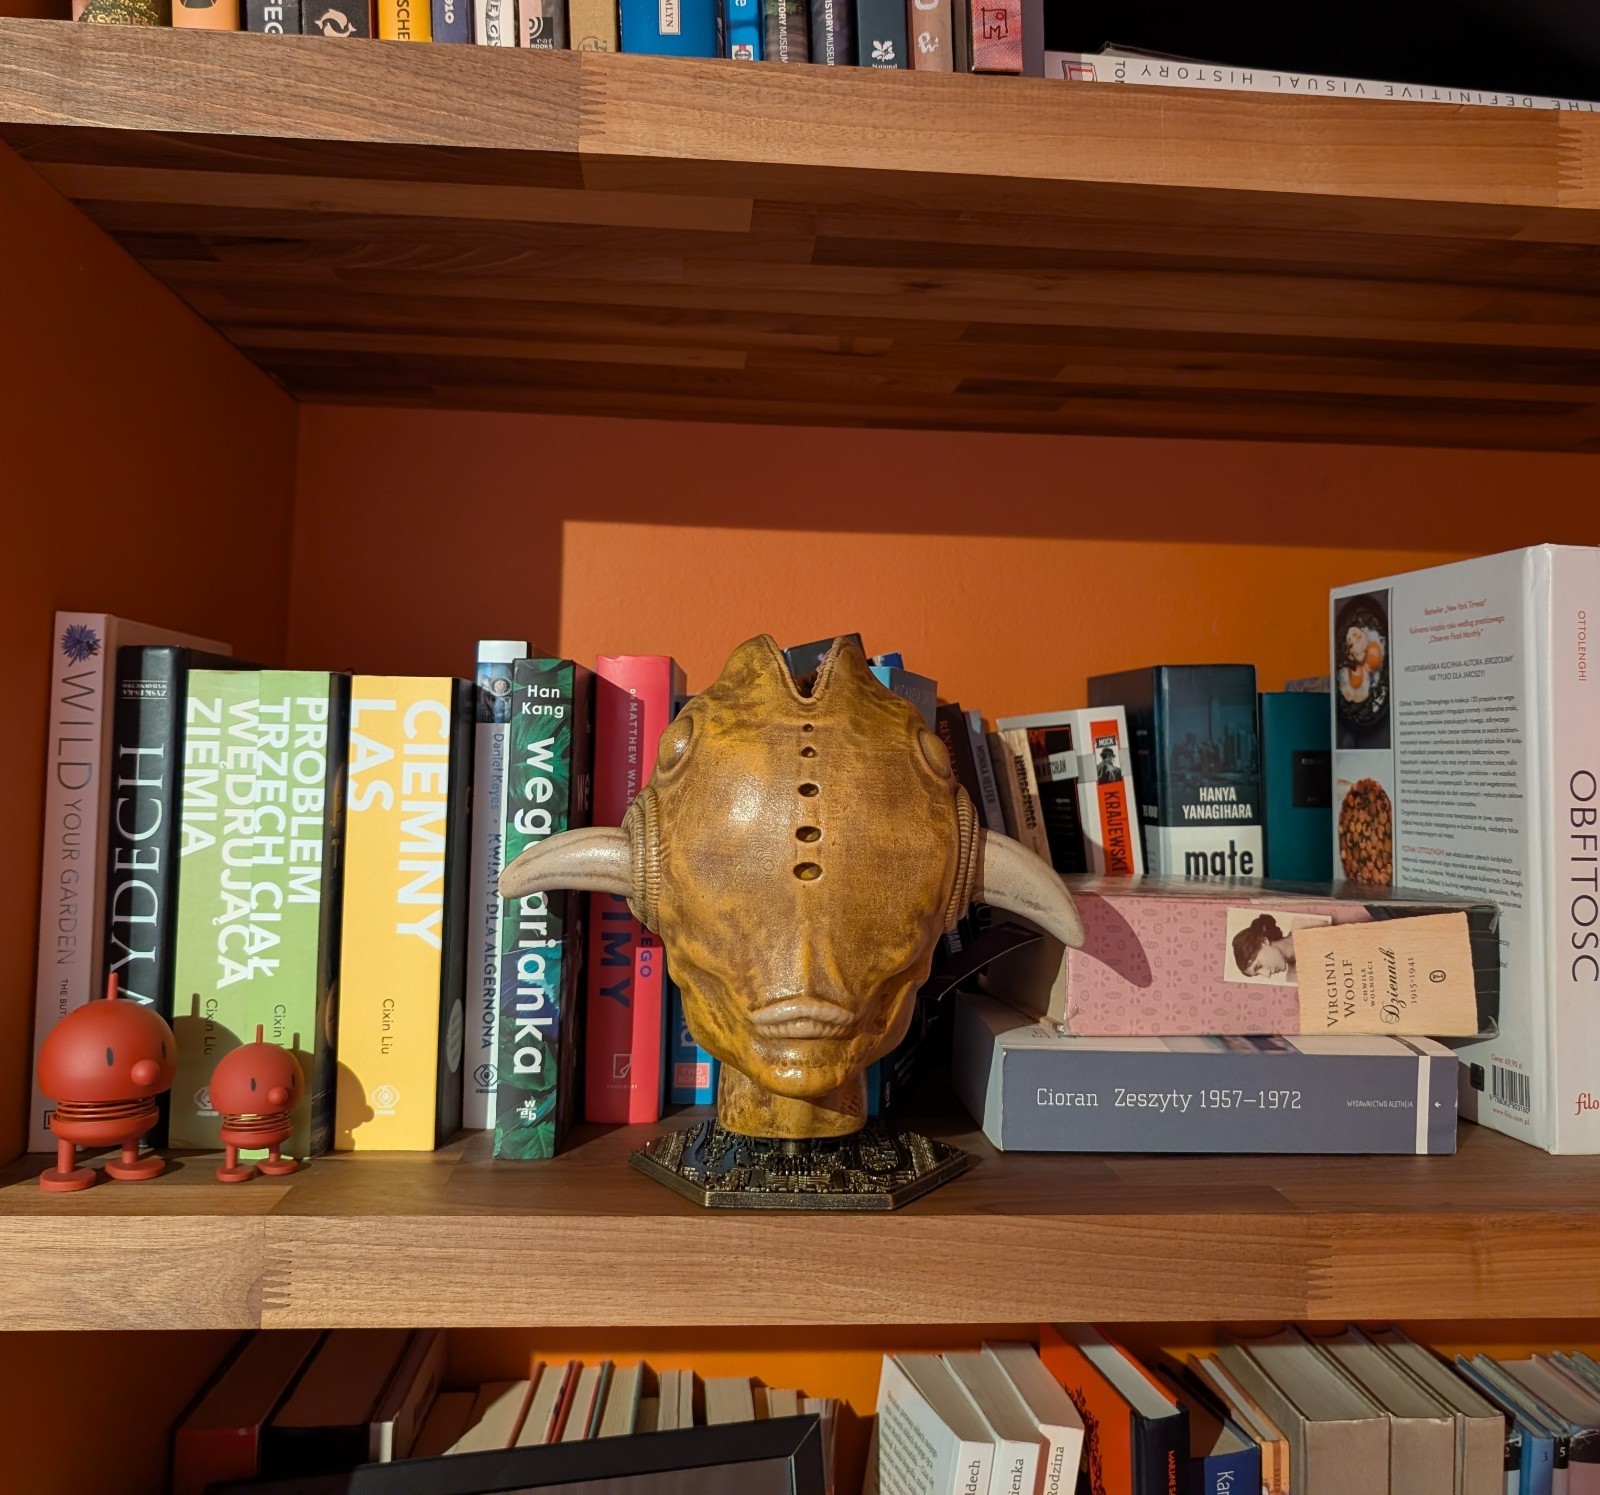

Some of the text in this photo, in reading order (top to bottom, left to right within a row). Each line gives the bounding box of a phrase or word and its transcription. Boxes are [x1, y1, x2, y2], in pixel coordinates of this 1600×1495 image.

[1114, 60, 1126, 83] TO
[1141, 64, 1253, 85] HISTORY
[1272, 75, 1366, 95] VISUAL
[1384, 85, 1533, 108] DEFINITIVE
[1577, 610, 1587, 682] OTTOLENGHI
[522, 701, 564, 719] Kang
[527, 684, 560, 699] Han
[57, 670, 97, 791] WILD
[347, 699, 397, 812] LAS
[628, 702, 638, 764] MATTHEW
[1098, 737, 1114, 747] MOCK
[180, 697, 223, 858] ZIEMIA
[288, 697, 329, 903] PROBLEM
[1199, 786, 1237, 802] HANYA
[61, 799, 83, 860] YOUR
[247, 697, 291, 981] TRZECH CIAŁ
[396, 699, 450, 950] CIEMNY
[1104, 790, 1128, 872] KRAJEWSKI
[1182, 804, 1253, 819] YANAGIHARA
[212, 698, 260, 990] WĘDRUJĄCA
[57, 870, 80, 965] GARDEN
[481, 733, 505, 1049] Daniel Keyes KWIATY DLA ALGERNONA
[512, 737, 556, 1074] wegarianka
[59, 978, 69, 996] THE
[1324, 950, 1339, 1029] VIRGINIA
[1342, 959, 1356, 1018] WOOLF
[1361, 967, 1369, 1001] CHWILE
[1378, 947, 1406, 1025] Dziennik
[1407, 956, 1418, 1004] 1915-1941
[203, 998, 218, 1056] Cixin Liu
[273, 1003, 287, 1038] Cixin
[381, 998, 395, 1055] Cixin Liu
[1036, 1087, 1099, 1107] Cioran
[1114, 1088, 1193, 1113] Zeszyty
[1346, 1099, 1388, 1107] WYDAWNICTWO
[1009, 1458, 1024, 1495] ienka
[1560, 1446, 1566, 1457] 5
